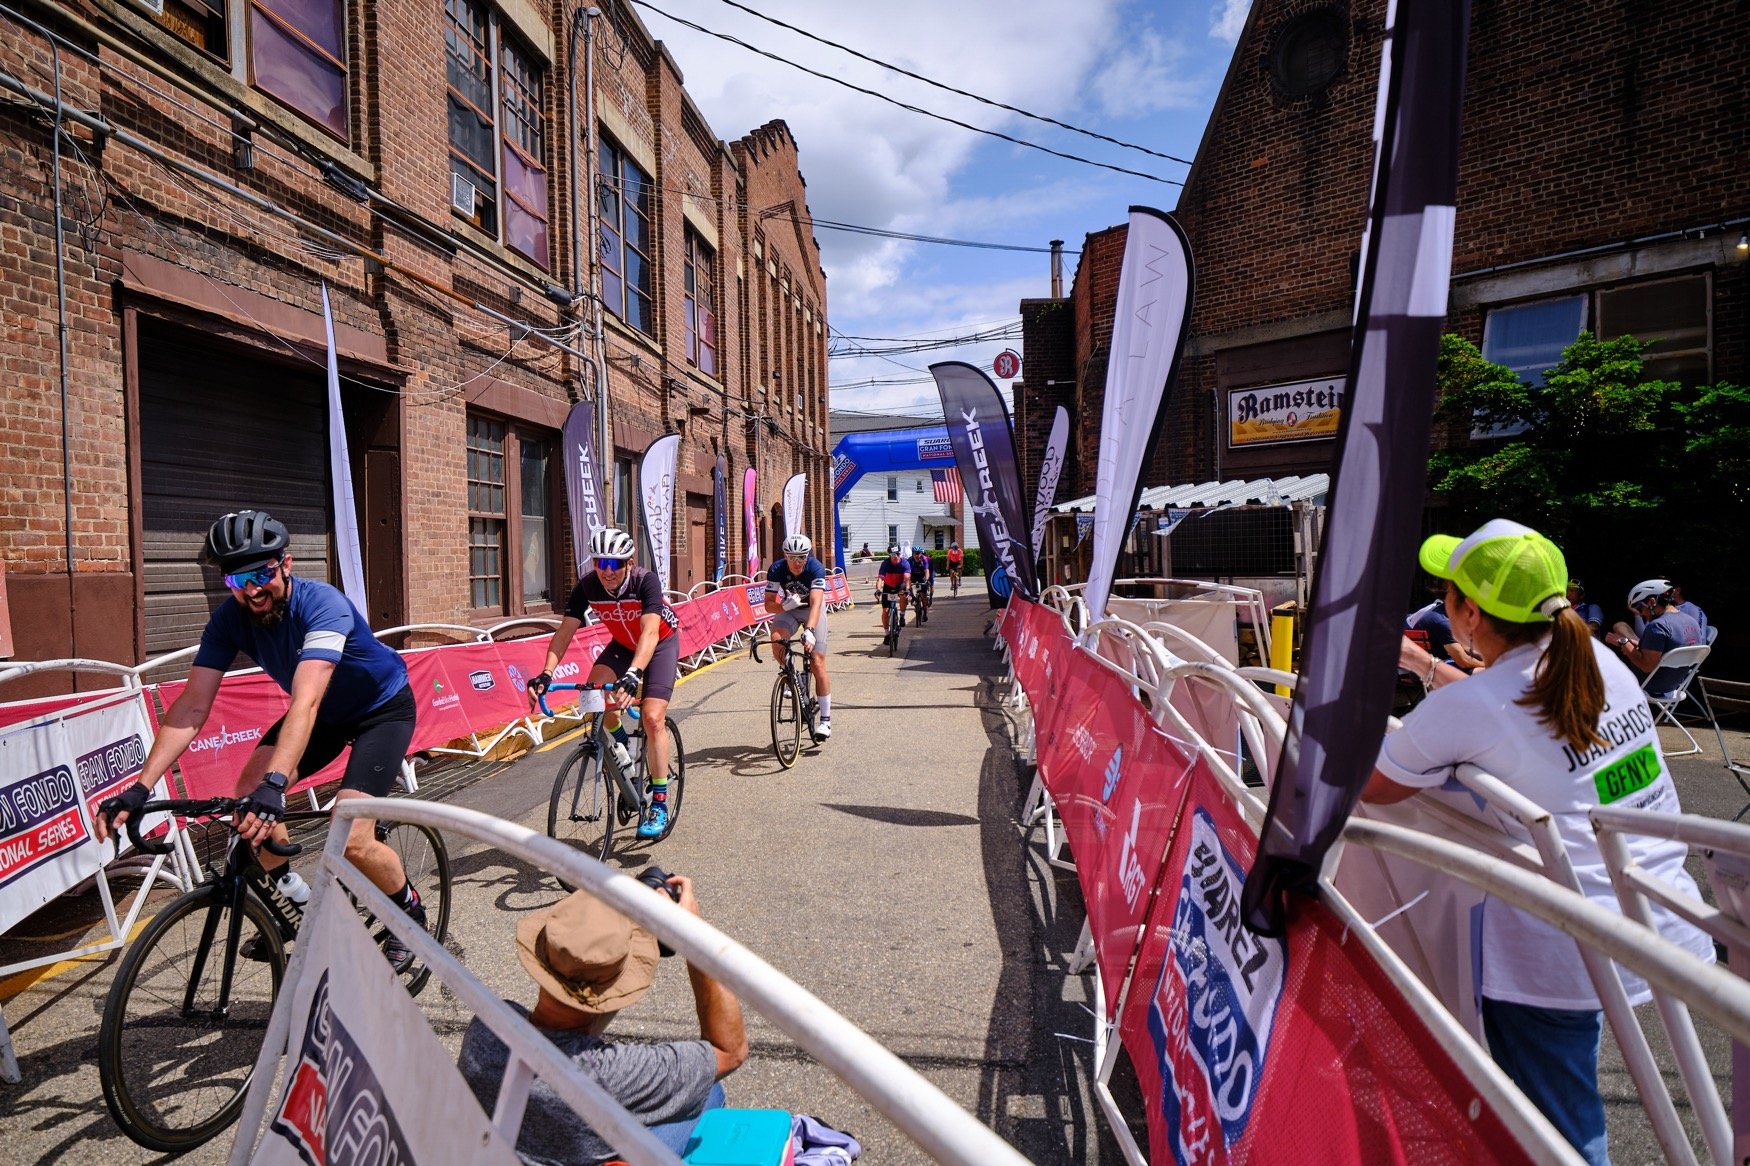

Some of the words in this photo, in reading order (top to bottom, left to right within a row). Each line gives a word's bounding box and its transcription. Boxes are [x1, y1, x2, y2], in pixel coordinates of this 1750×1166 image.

[834, 458, 850, 477] ONDO
[189, 736, 221, 753] CANE
[225, 727, 263, 745] CREEK
[77, 754, 109, 793] GRAN
[106, 738, 145, 777] FONDO
[1605, 751, 1651, 797] GFNY
[12, 770, 75, 823] FONDO
[38, 817, 77, 852] SERIES
[257, 873, 303, 931] S-WOR
[1123, 851, 1146, 915] RGT
